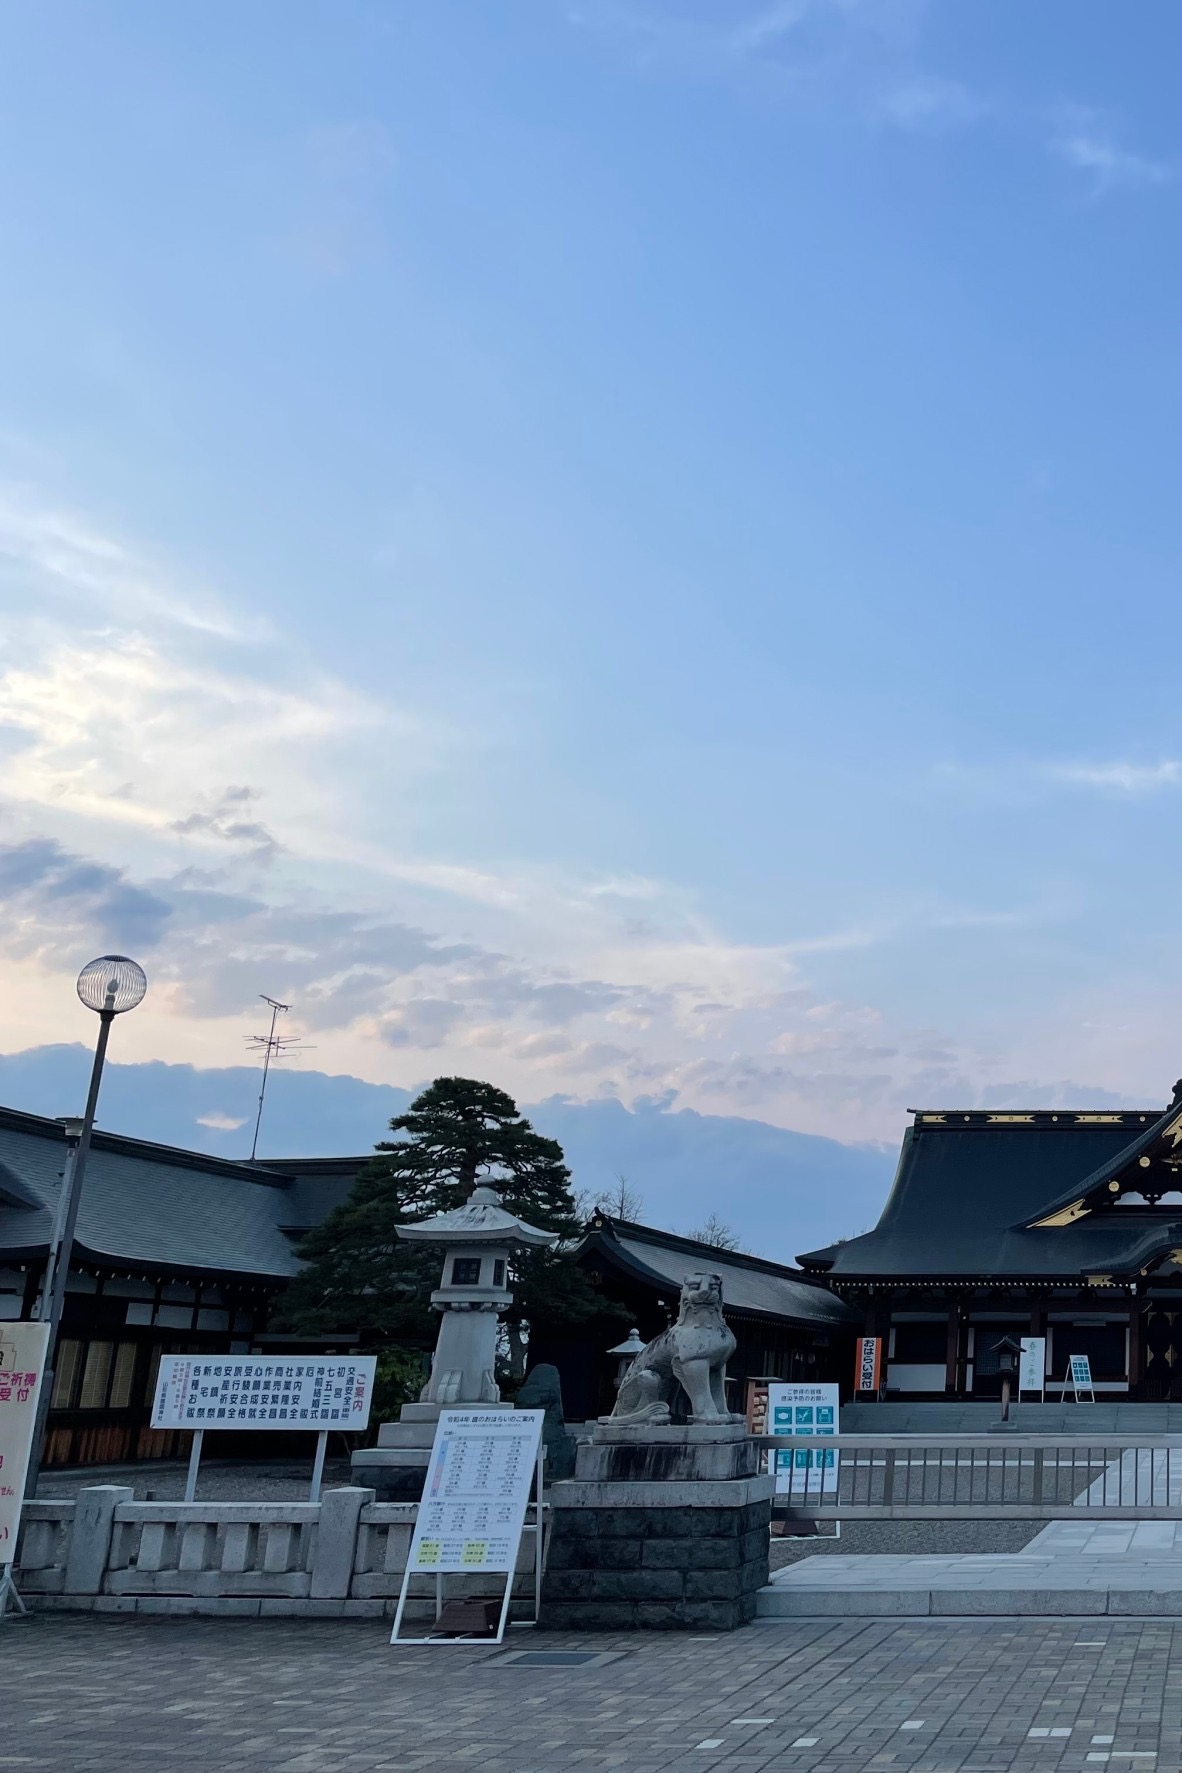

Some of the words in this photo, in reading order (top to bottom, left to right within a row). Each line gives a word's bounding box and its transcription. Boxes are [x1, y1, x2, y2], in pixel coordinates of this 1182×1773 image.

[861, 1339, 875, 1388] おはらい受付
[196, 1365, 212, 1418] 新宅祭
[206, 1365, 222, 1418] 地鎮祭
[216, 1365, 232, 1419] 安産祈願
[227, 1365, 242, 1419] 旅行安全
[237, 1365, 253, 1419] 受験合格
[248, 1366, 263, 1419] 心願成就
[258, 1366, 274, 1419] 作業安全
[289, 1366, 304, 1419] 家内安全
[310, 1366, 325, 1419] 神前結婚式
[353, 1373, 367, 1411] ご案内
